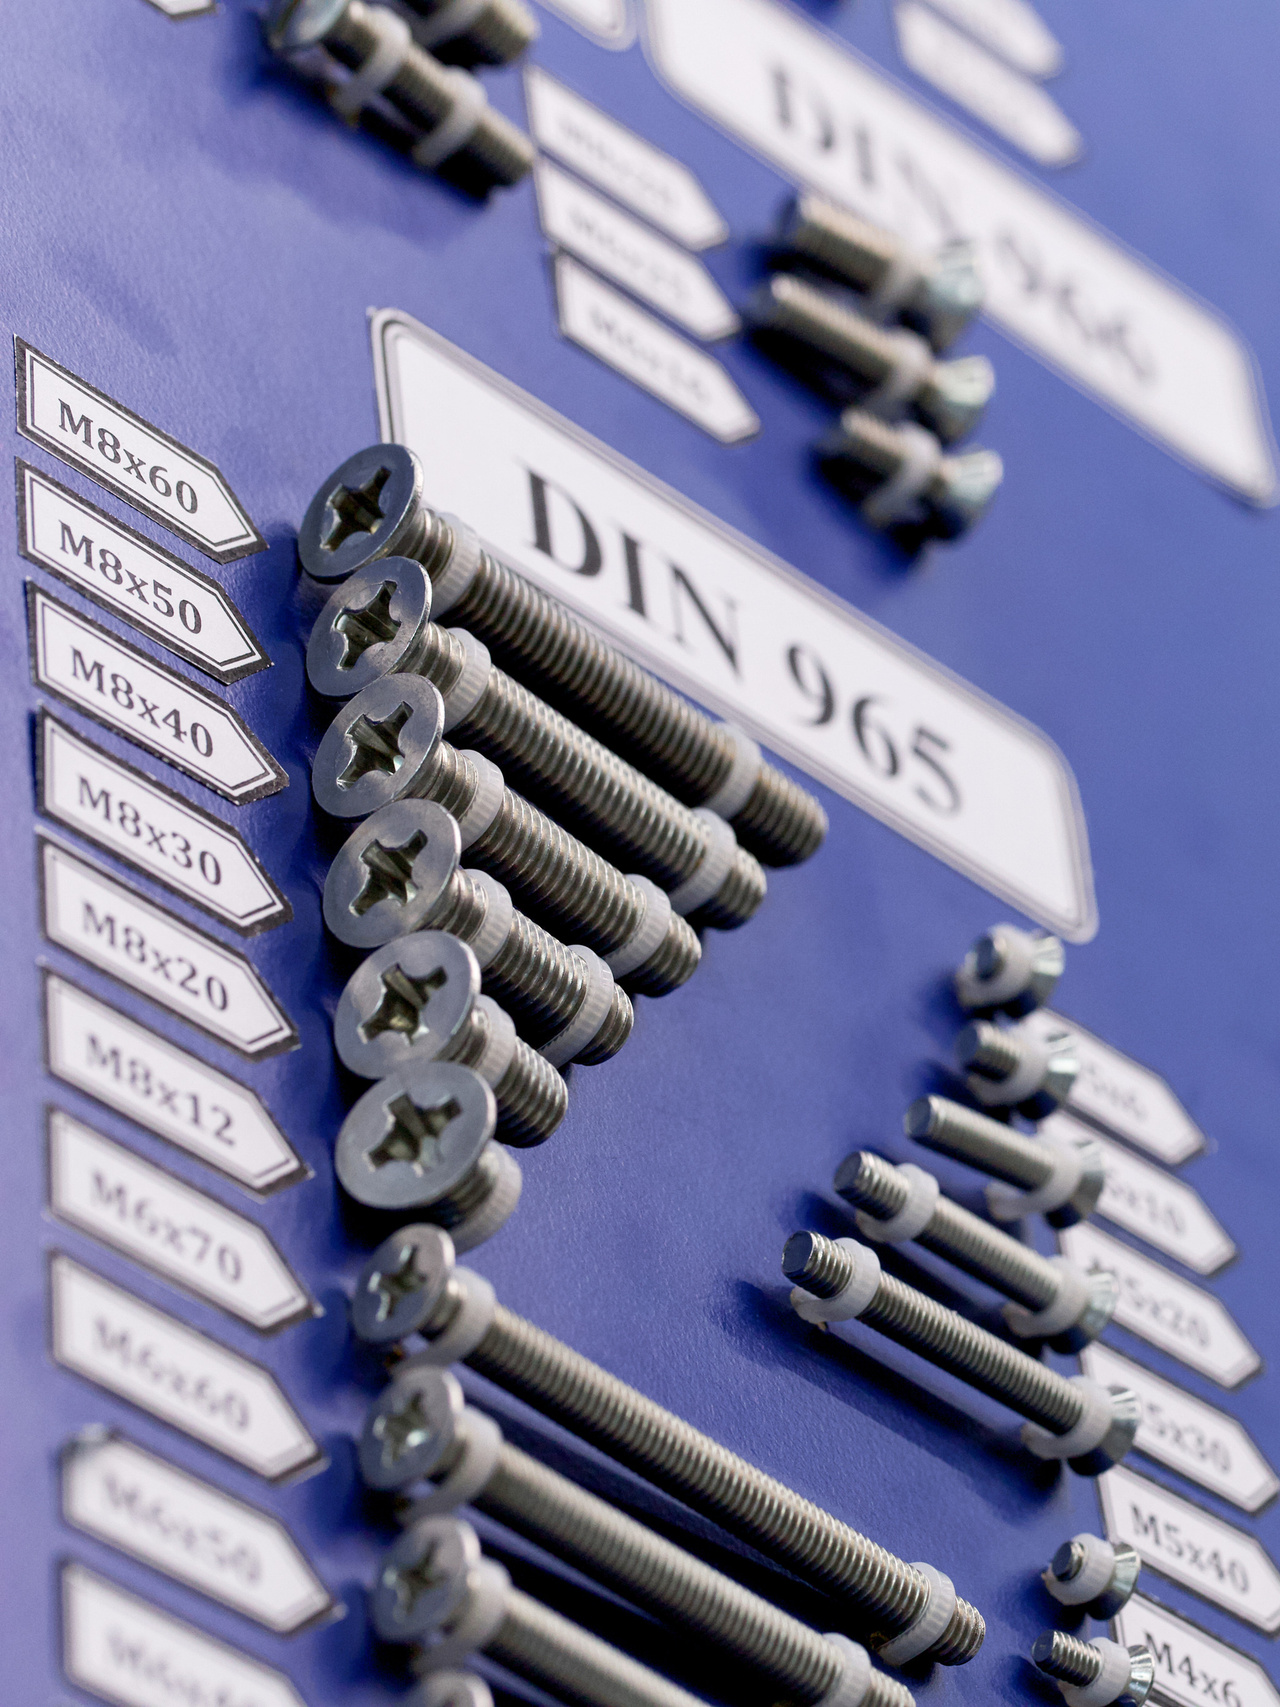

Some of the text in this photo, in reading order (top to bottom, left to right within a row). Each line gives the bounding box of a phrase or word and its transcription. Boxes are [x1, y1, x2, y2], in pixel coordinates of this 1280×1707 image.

[57, 397, 199, 516] M8x60
[58, 519, 203, 635] M8x50
[515, 454, 965, 820] DIN 965
[71, 645, 214, 758] M8x40
[78, 773, 222, 886] M8x30
[81, 898, 230, 1013] M8x20
[86, 1032, 237, 1148] M8x12
[90, 1168, 243, 1284] M6x70
[1146, 1400, 1232, 1475] 5x30
[1131, 1502, 1250, 1594] M5x40
